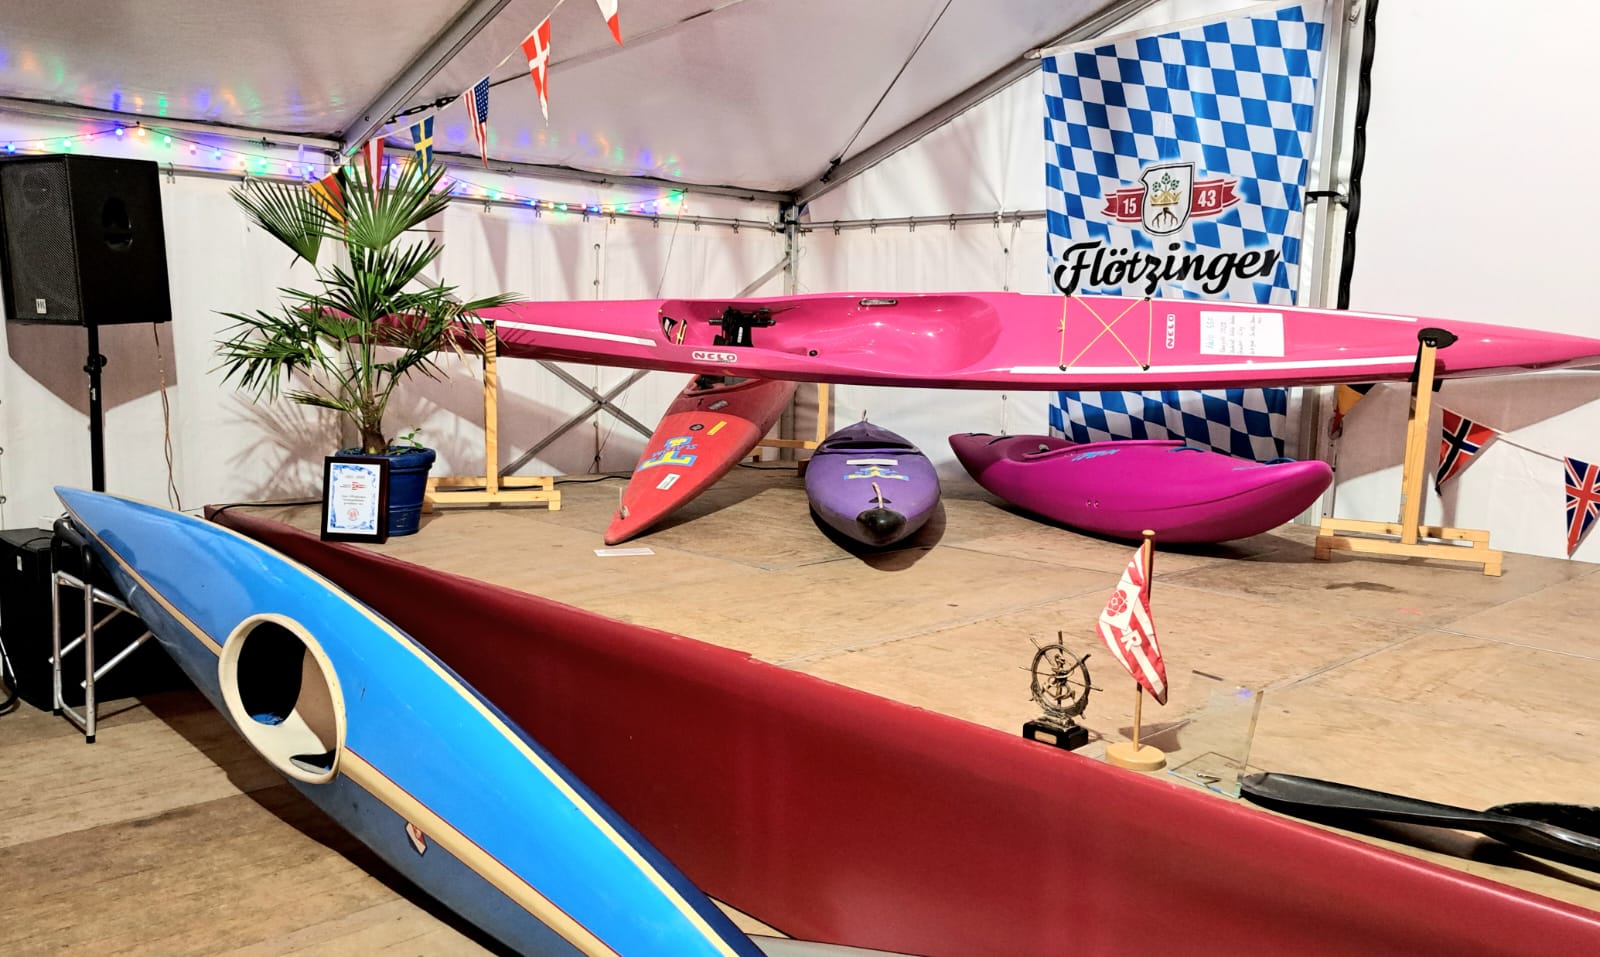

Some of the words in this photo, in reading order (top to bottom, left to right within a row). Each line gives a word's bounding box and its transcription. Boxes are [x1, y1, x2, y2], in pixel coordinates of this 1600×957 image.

[1123, 197, 1137, 215] 15
[1197, 189, 1217, 208] 43
[1054, 238, 1281, 295] Flötzinger
[1167, 314, 1175, 348] NELO
[693, 351, 737, 361] NELO
